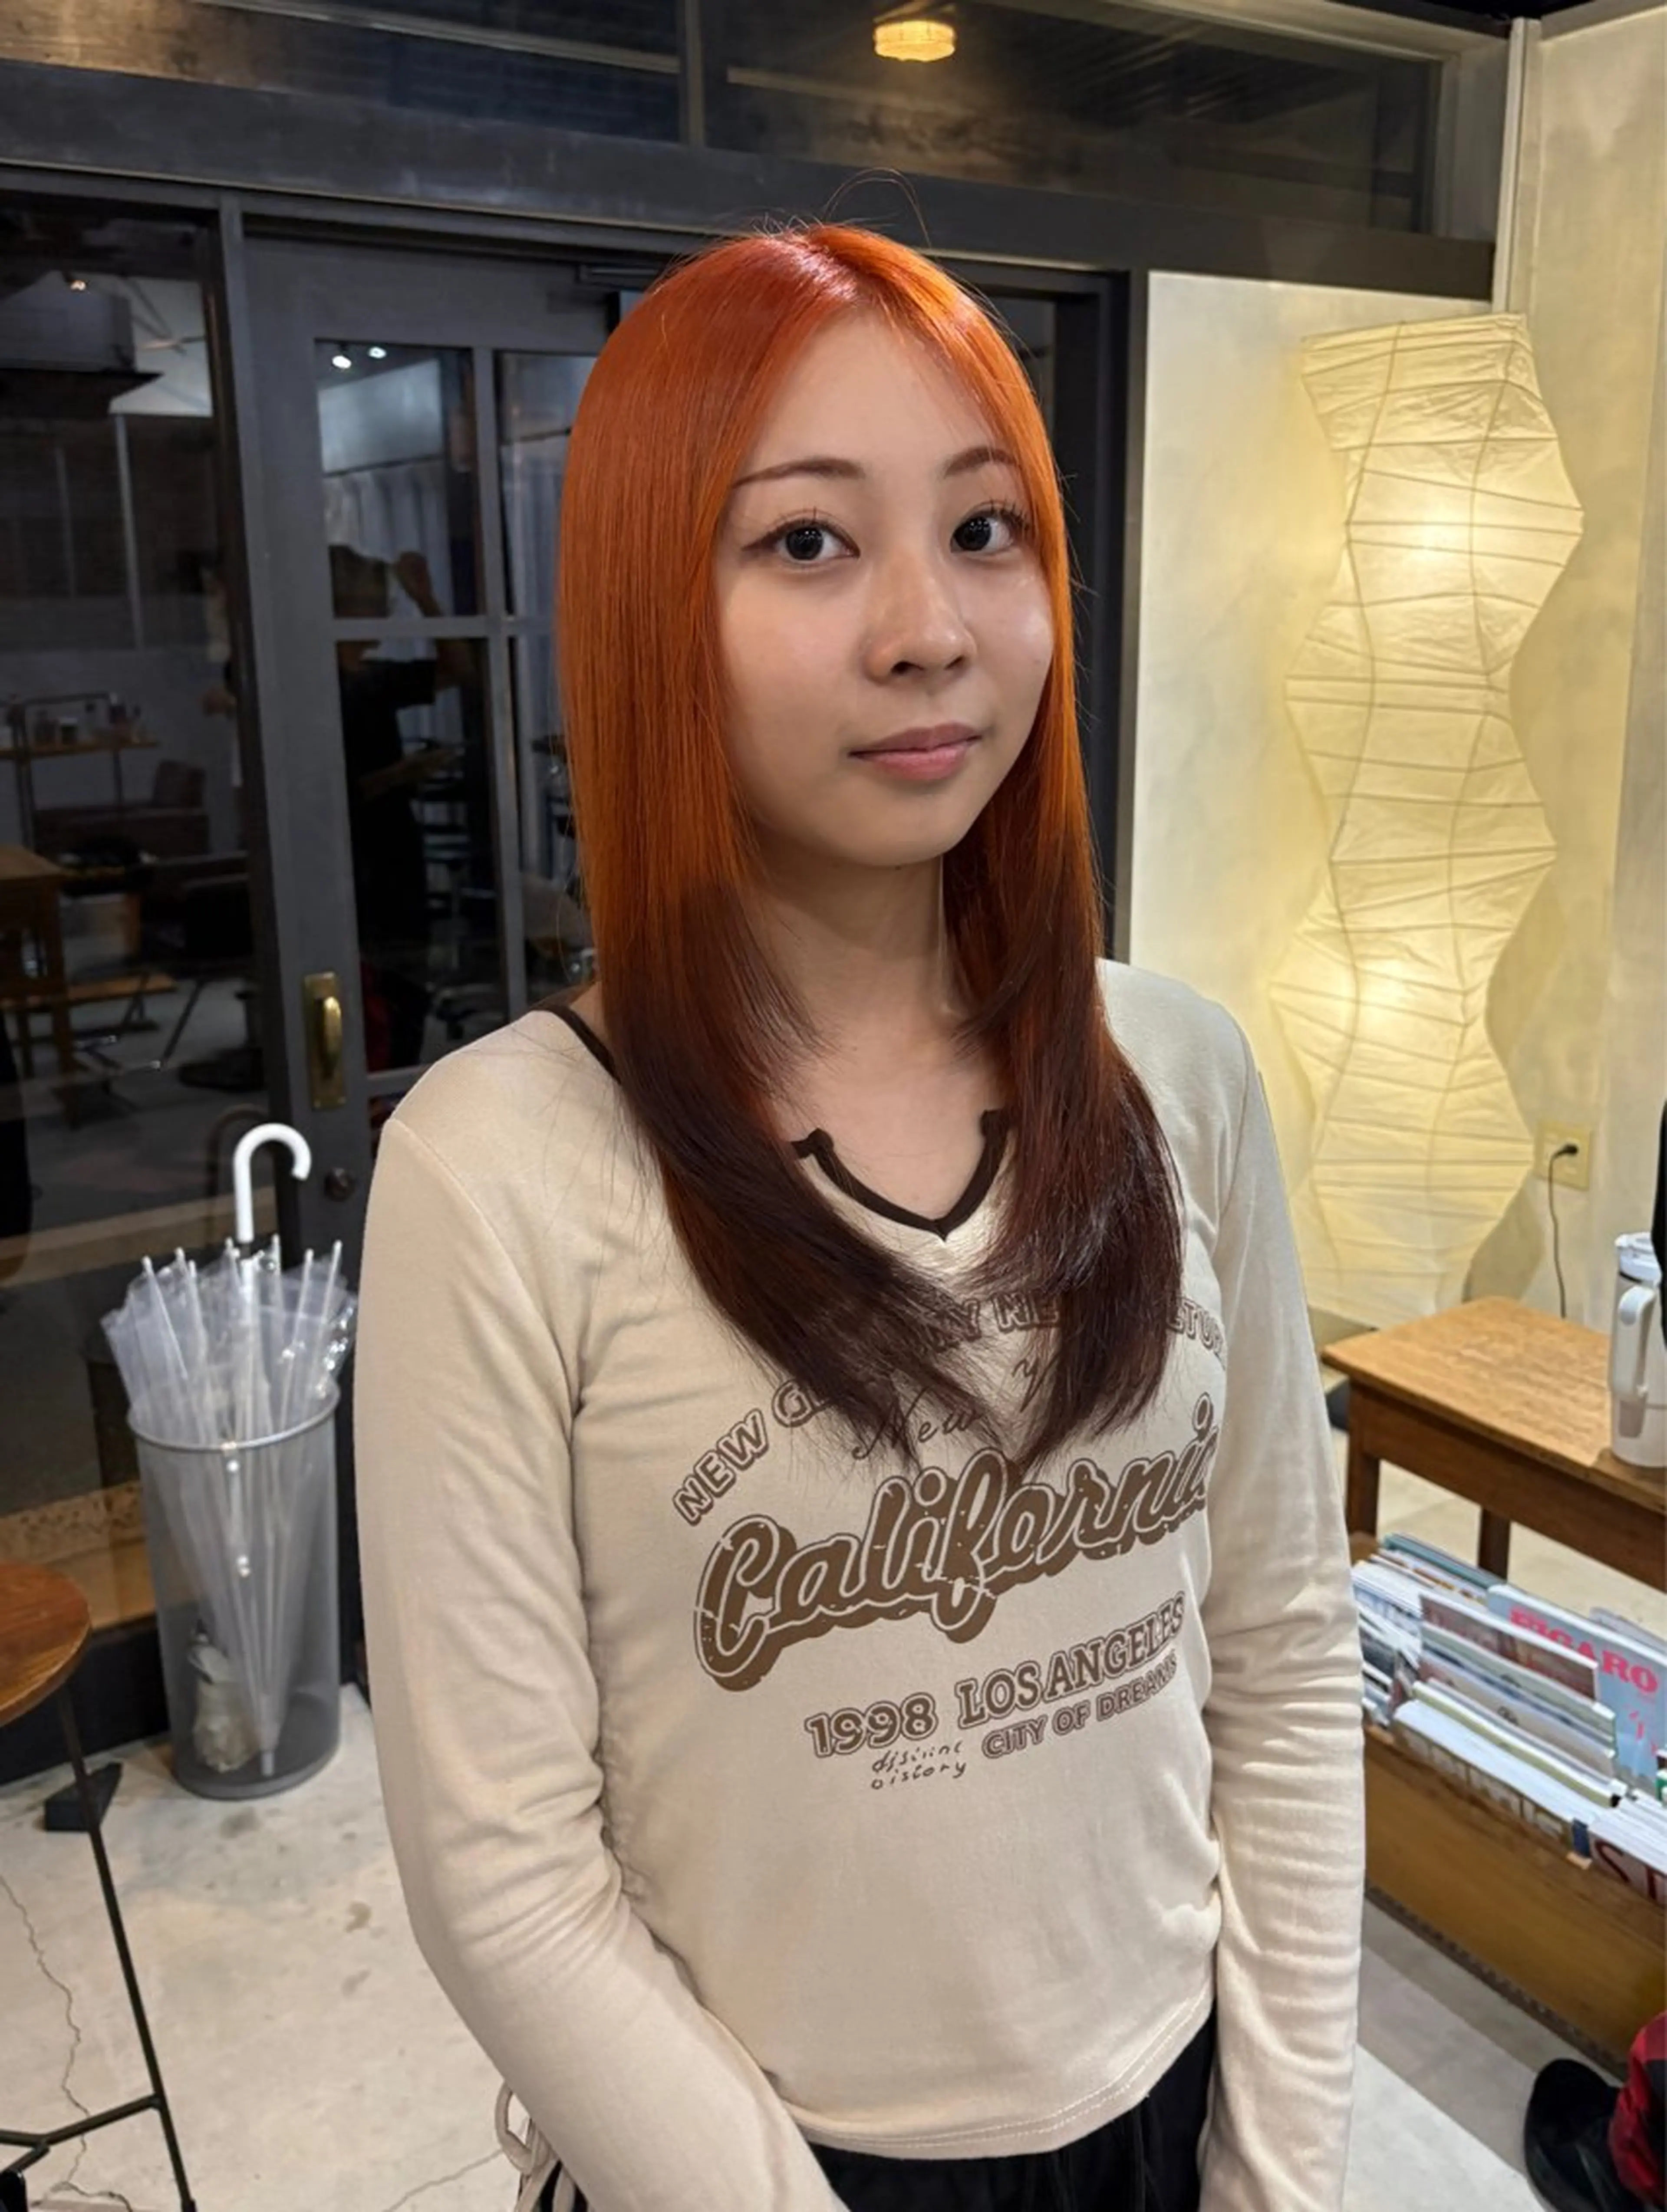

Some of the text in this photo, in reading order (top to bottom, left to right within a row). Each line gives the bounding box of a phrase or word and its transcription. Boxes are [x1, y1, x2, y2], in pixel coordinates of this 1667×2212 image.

[673, 1408, 769, 1526] NEW
[804, 1591, 1186, 1758] 1998 LOS ANGELES
[982, 1649, 1178, 1759] CITY OF DREAMS
